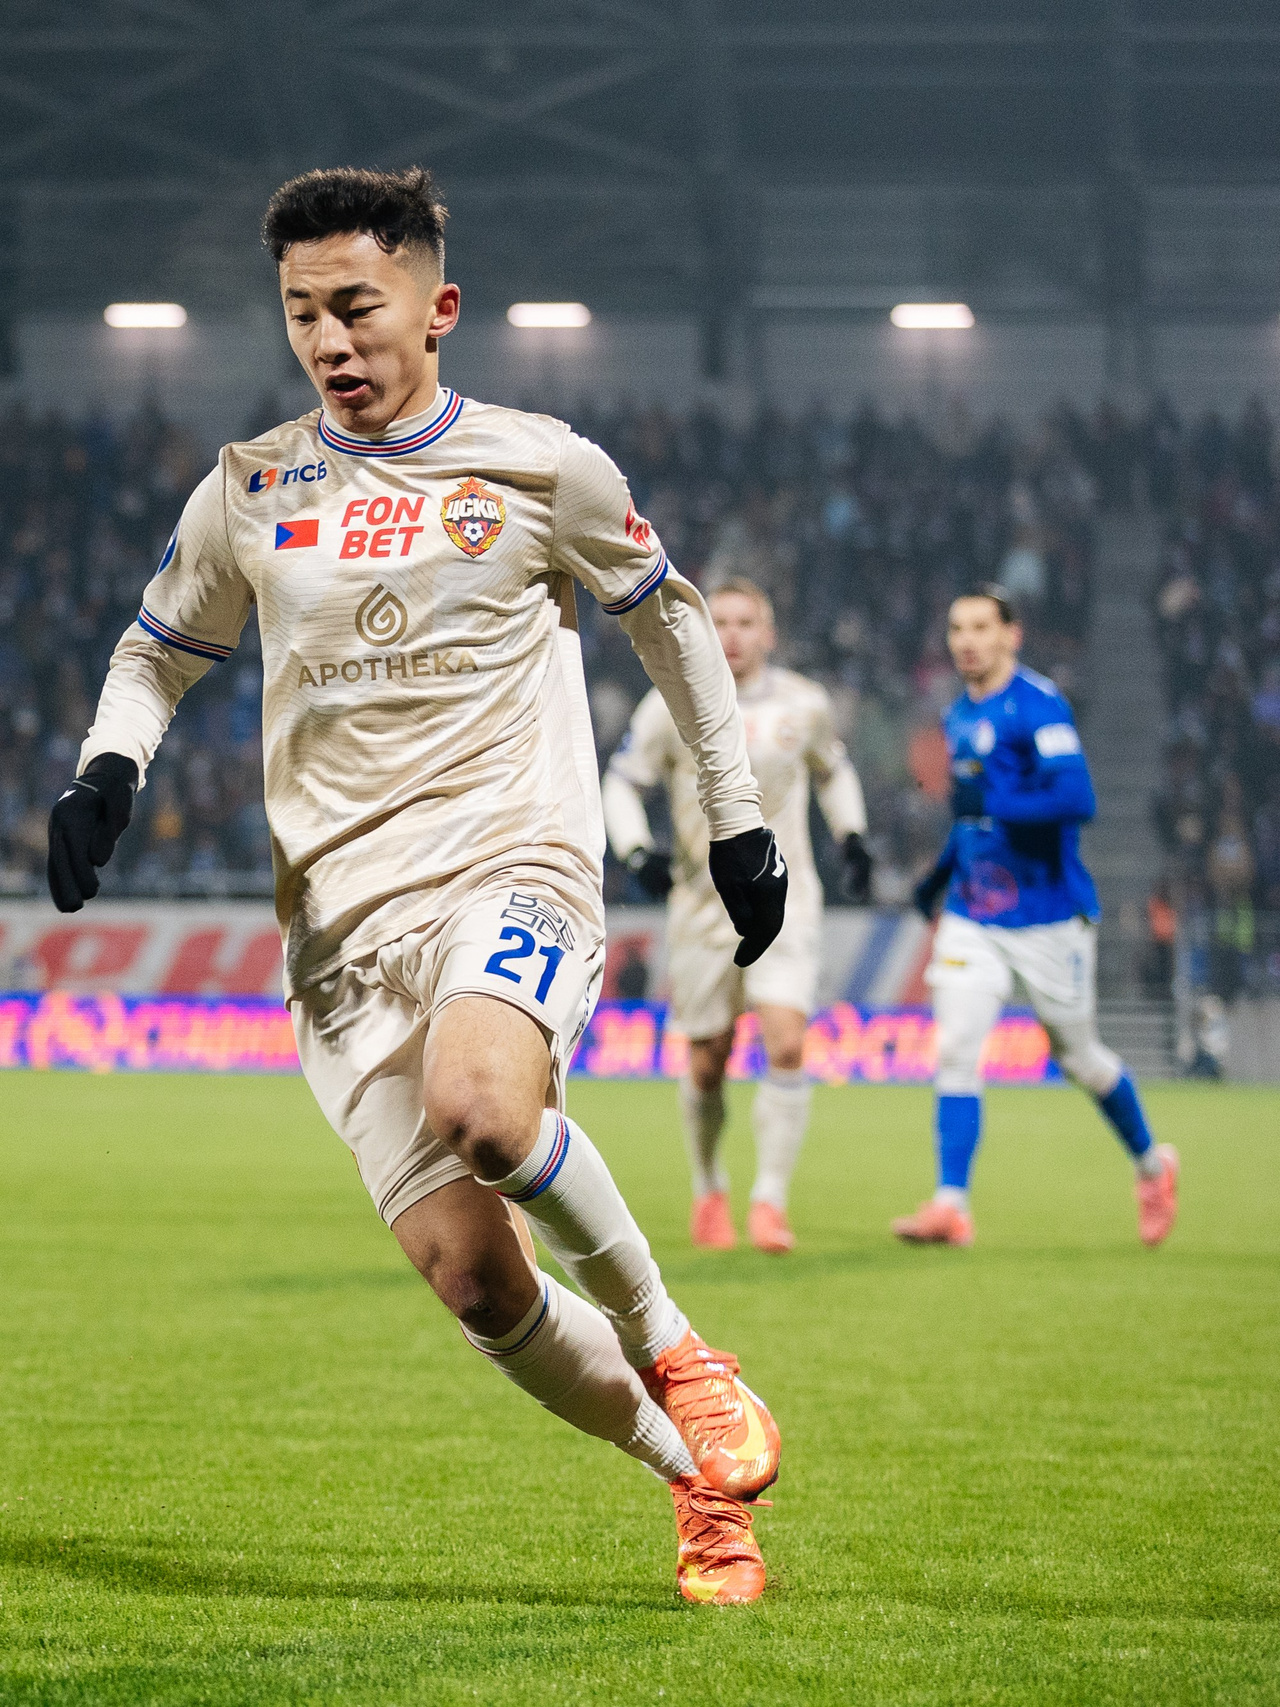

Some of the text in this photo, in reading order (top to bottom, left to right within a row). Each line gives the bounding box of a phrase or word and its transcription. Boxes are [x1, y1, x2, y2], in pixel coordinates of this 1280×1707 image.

[282, 460, 327, 485] ПСБ
[341, 496, 425, 527] FON
[445, 497, 502, 521] ЦСКА
[339, 526, 424, 559] BET
[298, 651, 479, 689] APOTHEKA
[484, 926, 565, 1005] 21
